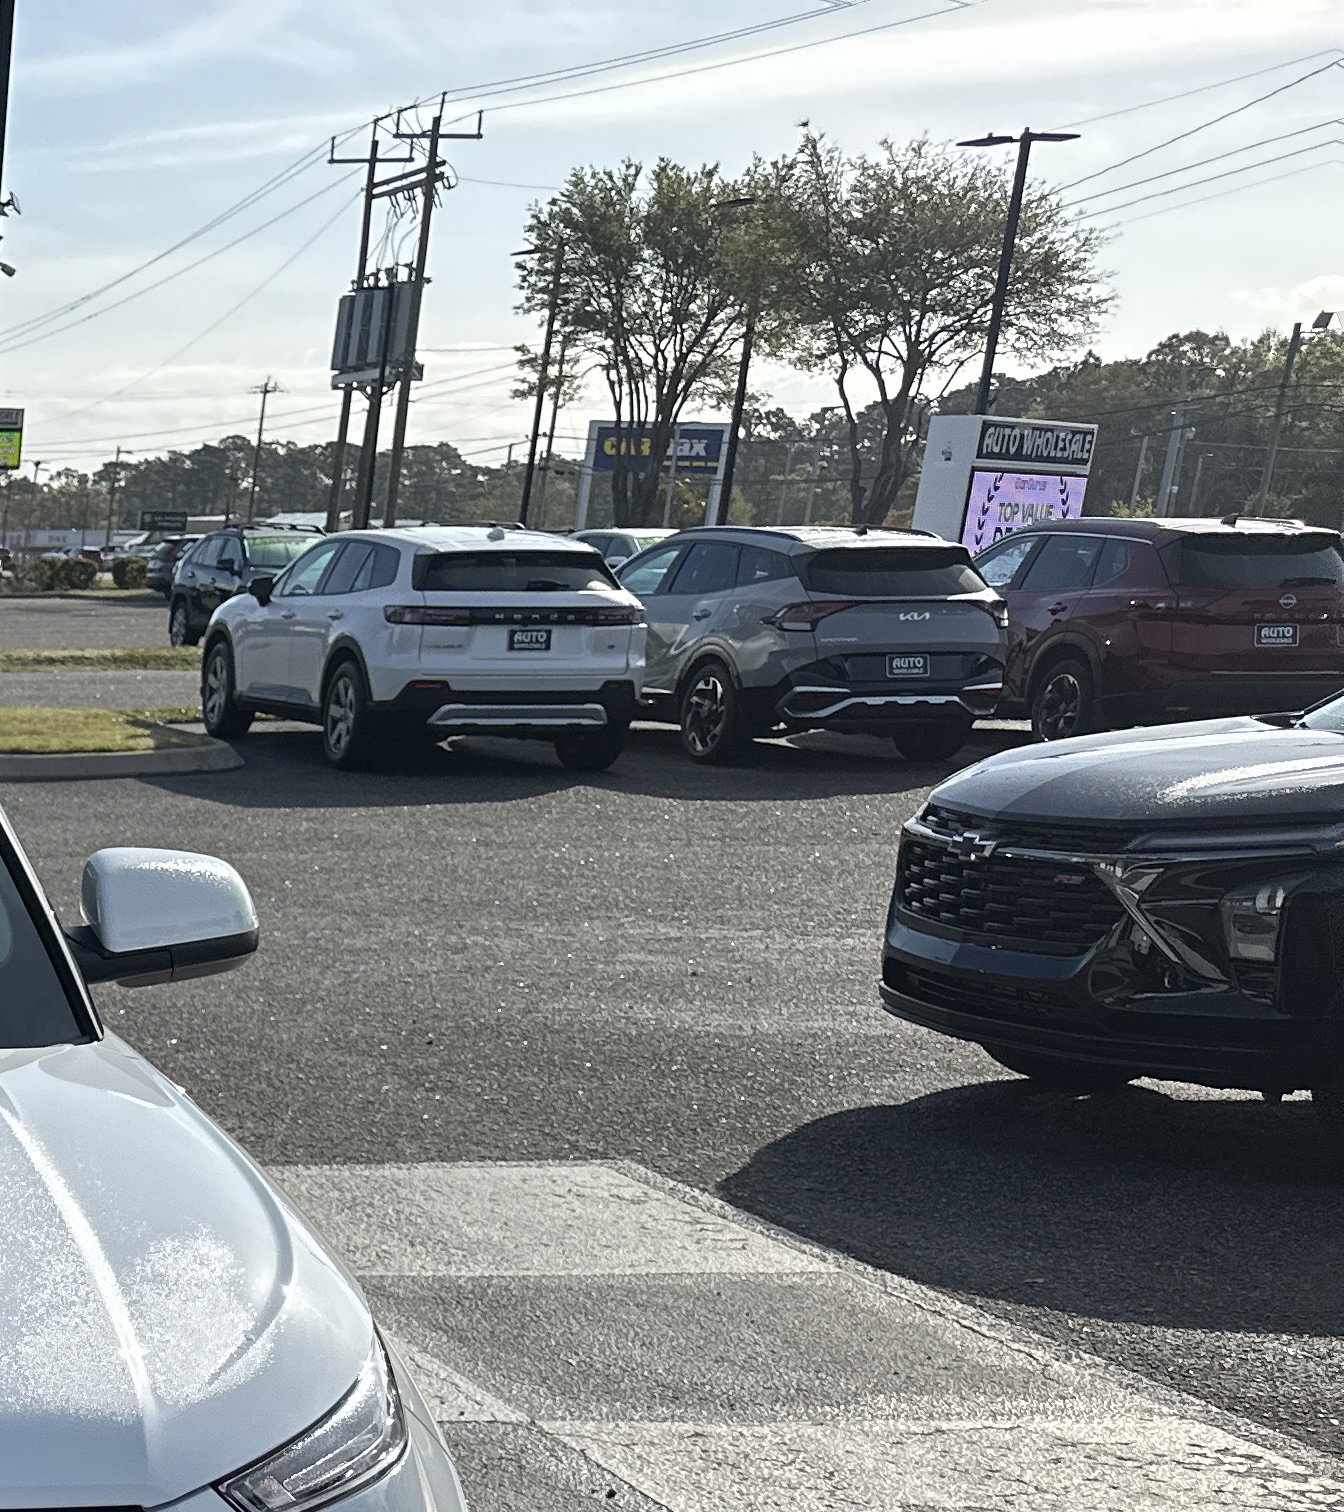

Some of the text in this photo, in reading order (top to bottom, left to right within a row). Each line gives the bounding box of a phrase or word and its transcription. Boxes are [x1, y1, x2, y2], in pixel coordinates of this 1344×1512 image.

[983, 427, 1092, 460] AUTO WHOLESALE
[998, 502, 1054, 523] TOP VALUE
[513, 631, 547, 643] AUTO
[1261, 627, 1293, 638] AUTO
[892, 657, 924, 668] AUTO
